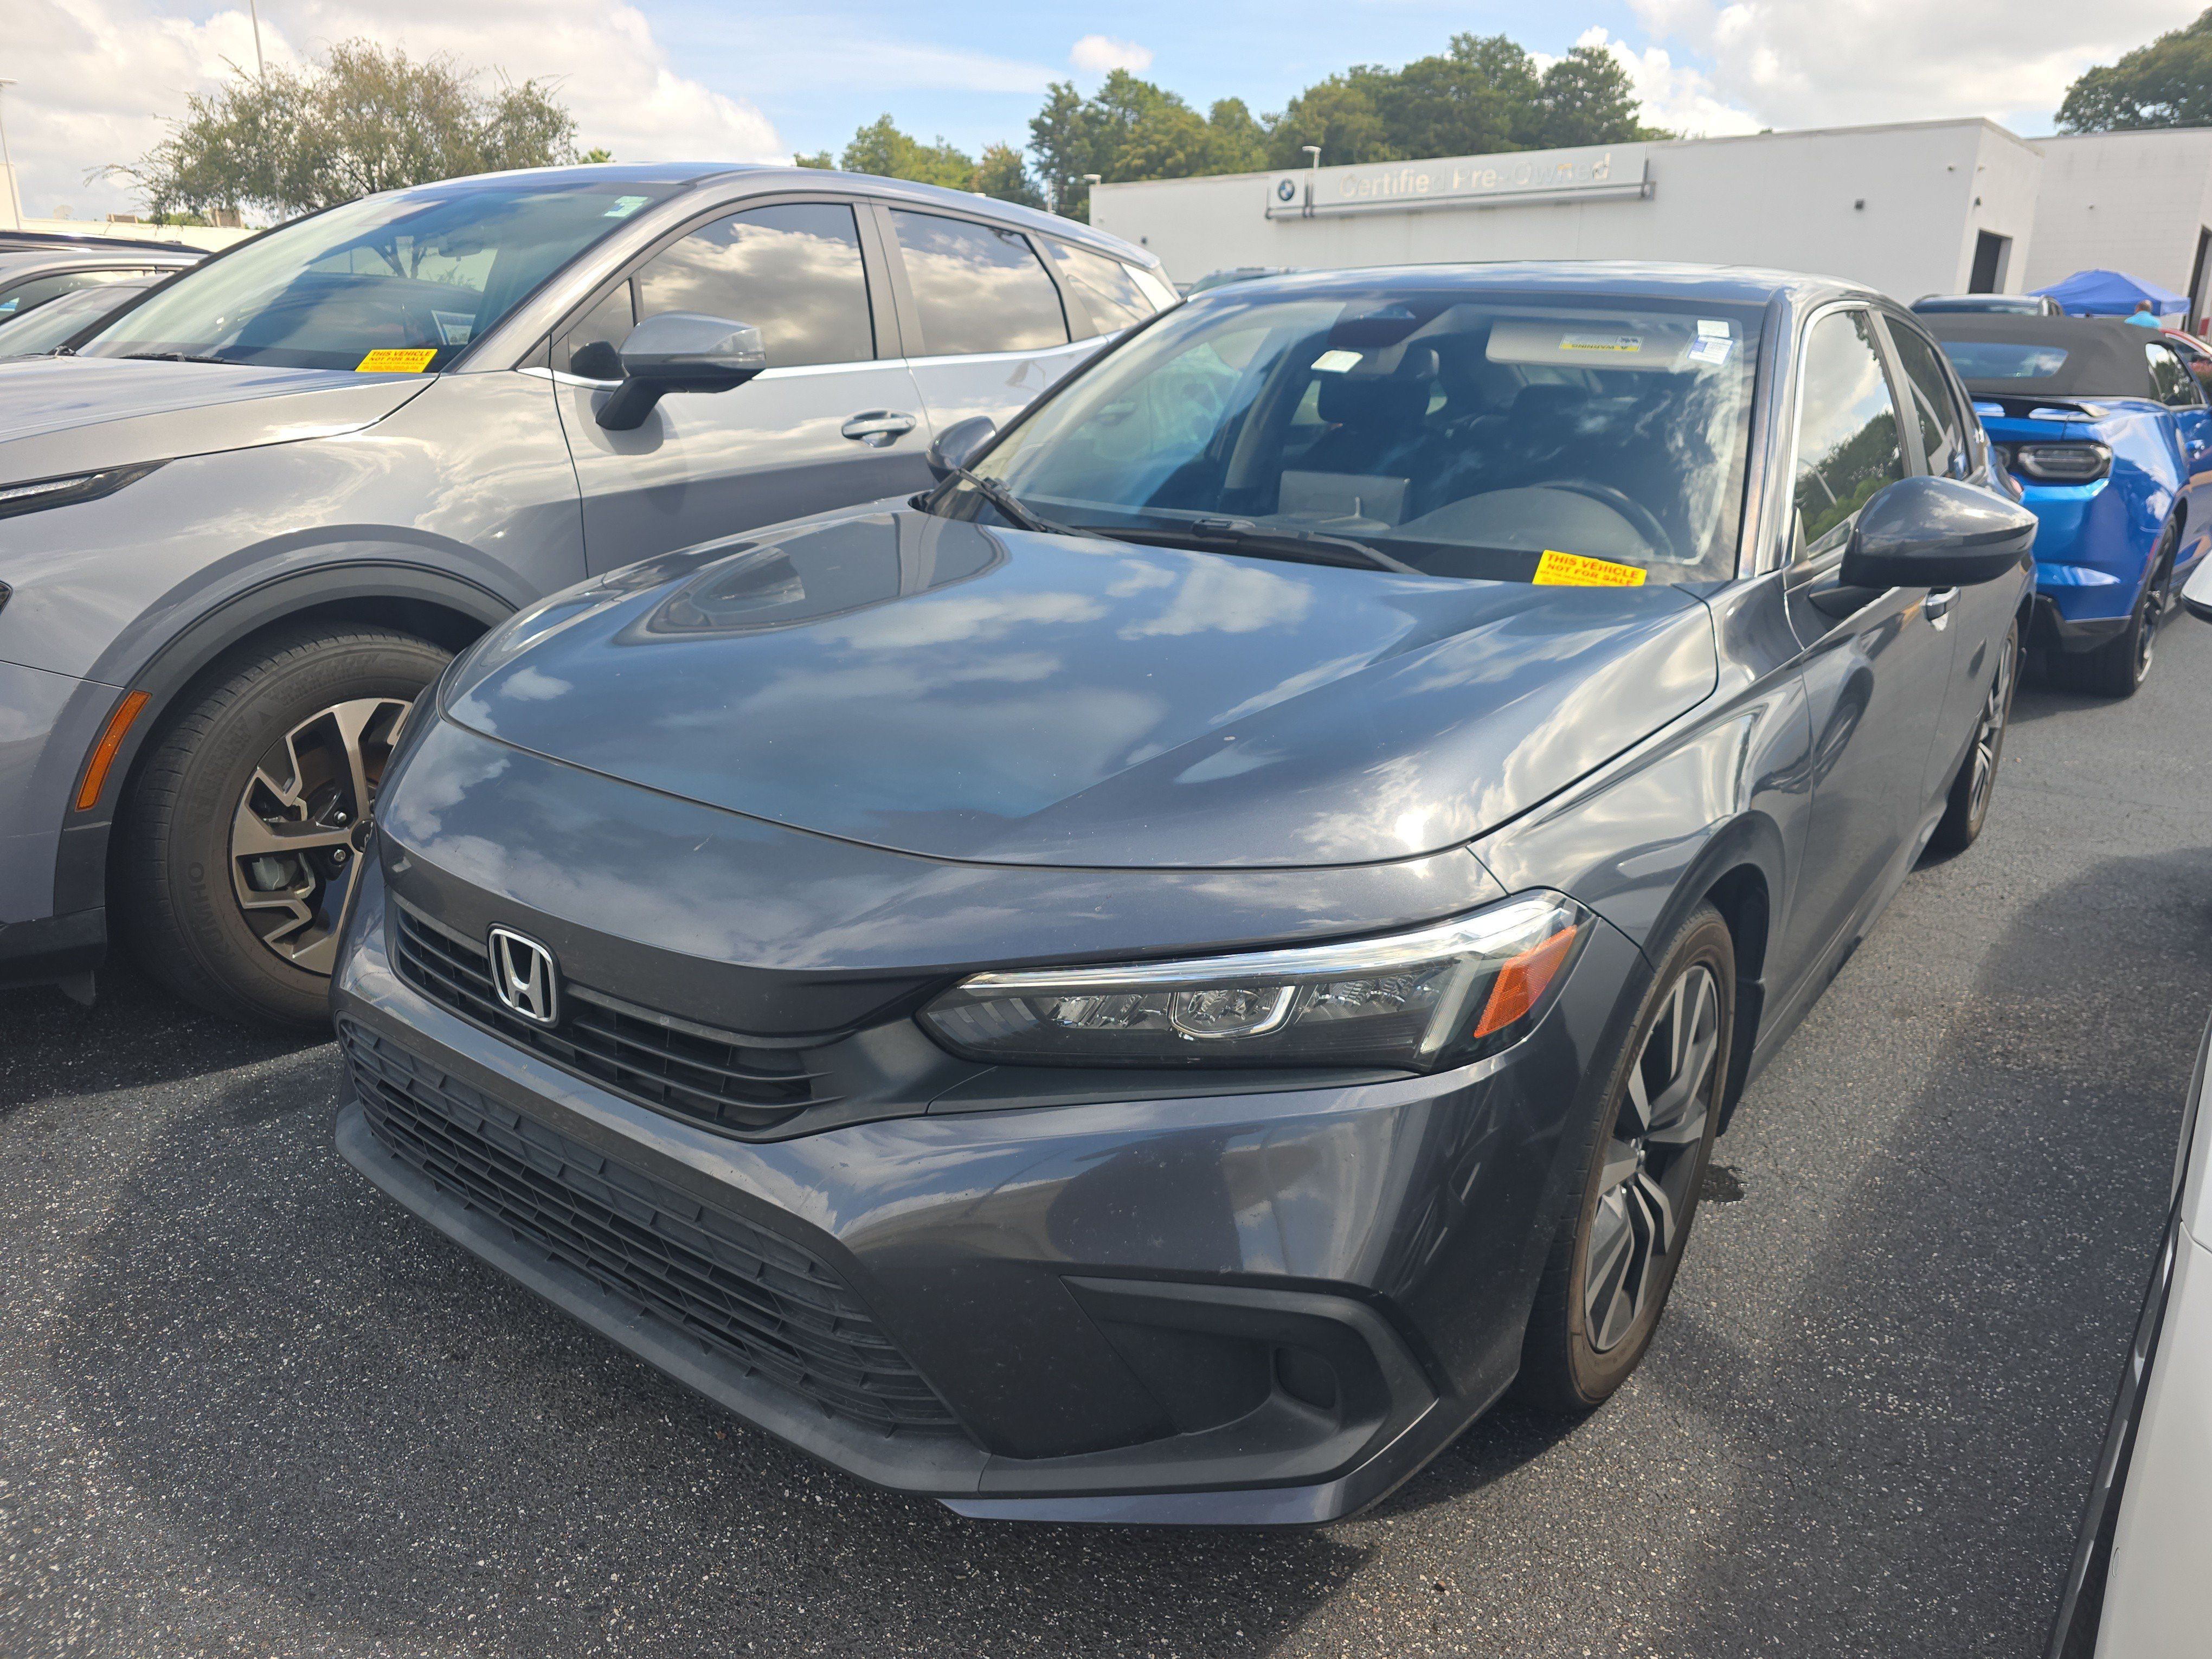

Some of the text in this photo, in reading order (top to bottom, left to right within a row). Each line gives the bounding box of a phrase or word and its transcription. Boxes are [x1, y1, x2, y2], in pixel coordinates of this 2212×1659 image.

[1547, 563, 1571, 573] NOT
[1574, 569, 1598, 578] FOR
[1603, 575, 1634, 586] SALE
[1548, 554, 1577, 565] THIS
[1583, 561, 1639, 578] VEHICLE
